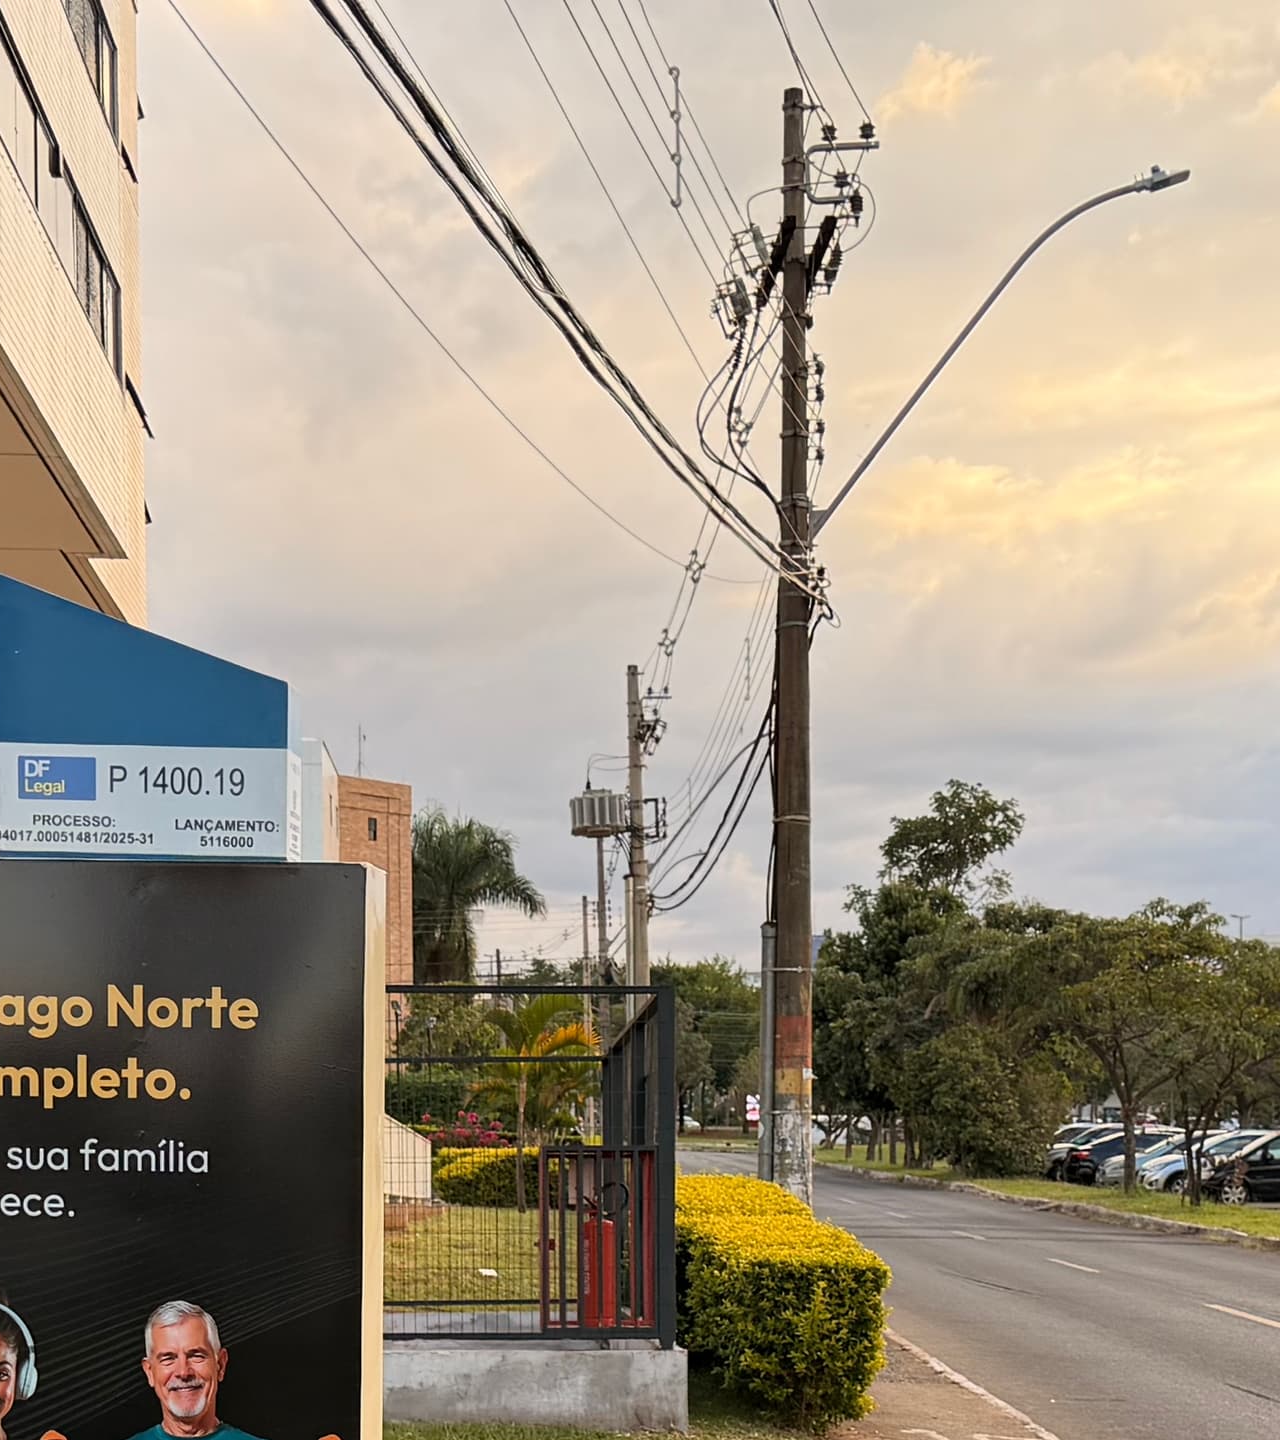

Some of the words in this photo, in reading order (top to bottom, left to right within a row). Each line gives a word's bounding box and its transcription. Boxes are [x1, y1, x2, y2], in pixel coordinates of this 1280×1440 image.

[24, 759, 51, 778] DF
[24, 779, 65, 796] Legal
[109, 765, 128, 793] P
[138, 766, 245, 796] 1400.19
[32, 814, 116, 828] PROCESSO:
[174, 818, 280, 835] LANÇAMENTO:
[199, 835, 254, 848] 5116000
[106, 983, 260, 1030] Norte
[6, 1147, 70, 1172] sua
[80, 1138, 209, 1175] família
